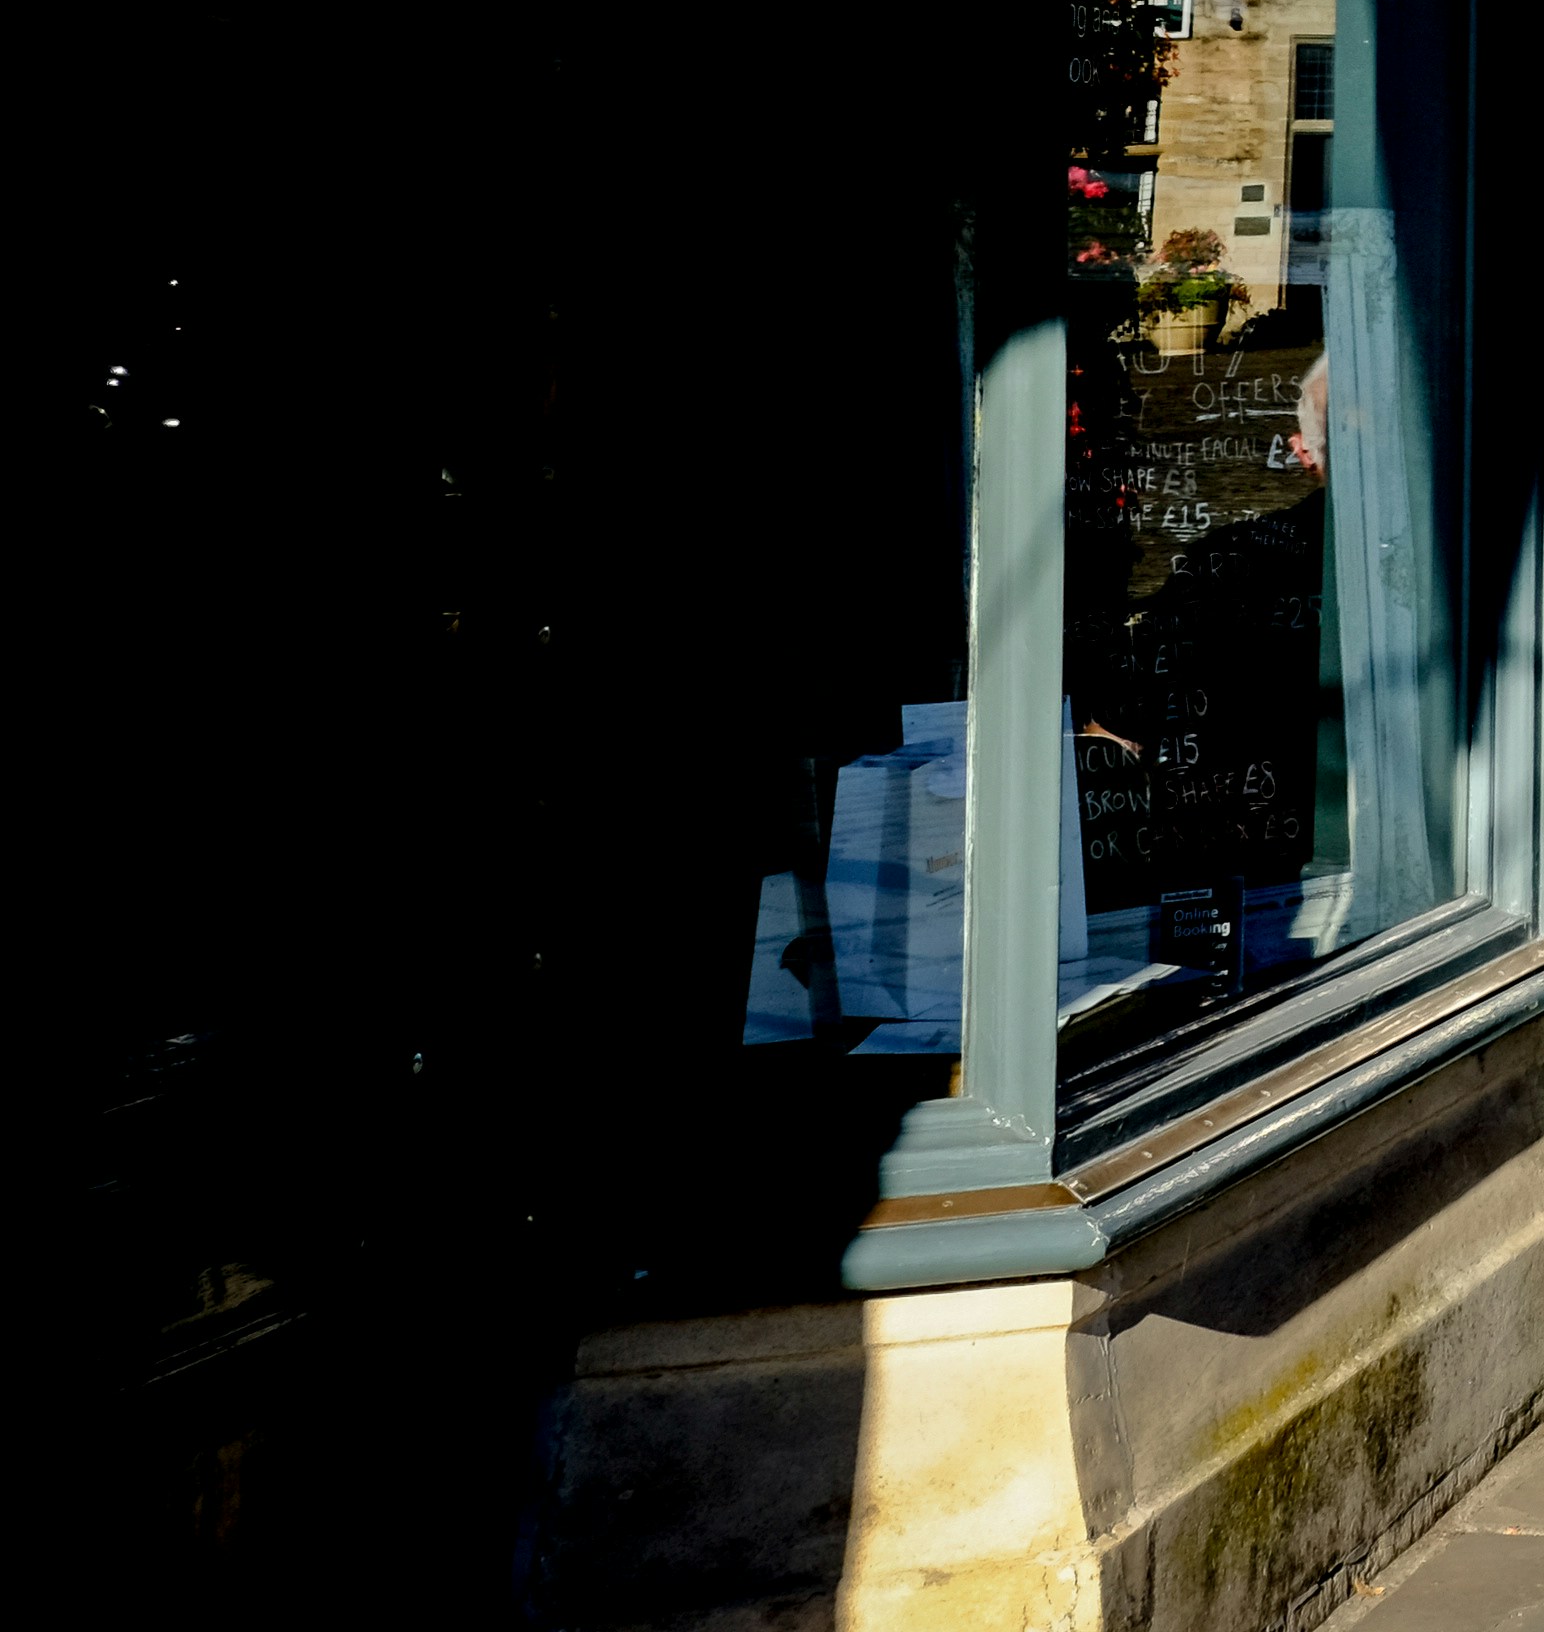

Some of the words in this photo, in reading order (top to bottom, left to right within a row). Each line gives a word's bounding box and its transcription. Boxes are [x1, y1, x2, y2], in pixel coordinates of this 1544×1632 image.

[1192, 373, 1304, 425] OFFERS
[1101, 466, 1158, 493] SHAPE
[1161, 502, 1212, 530] £15
[1242, 760, 1277, 799] £8
[1173, 907, 1220, 922] Online
[1173, 921, 1232, 938] Booking
